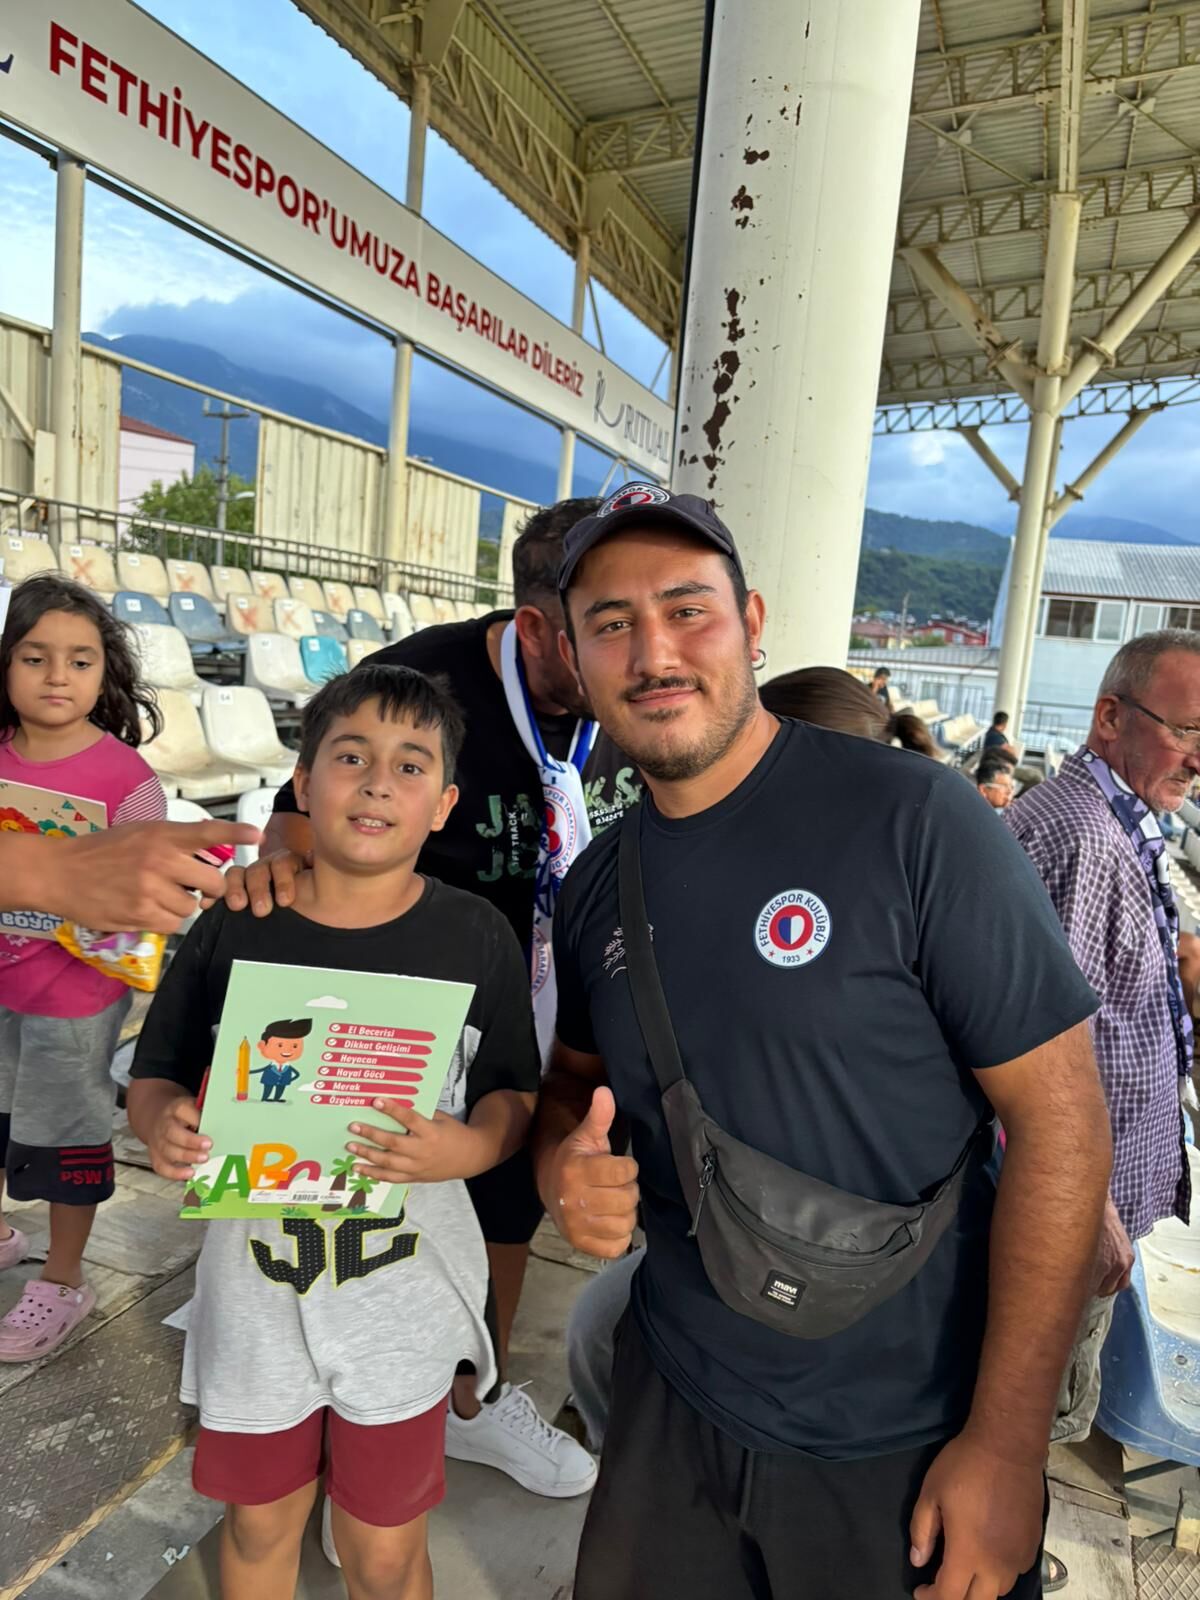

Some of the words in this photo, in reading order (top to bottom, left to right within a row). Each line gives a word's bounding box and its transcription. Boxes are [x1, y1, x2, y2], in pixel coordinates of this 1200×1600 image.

[50, 20, 421, 298] FETHİYESPOR'UMUZA
[426, 272, 529, 363] BAŞARILAR
[531, 341, 584, 398] DİLERİZ
[804, 896, 827, 942] KULÜBÜ
[782, 955, 800, 963] 1933
[359, 1026, 396, 1038] Becerisi
[344, 1039, 373, 1050] Dikkat
[375, 1042, 411, 1054] Gelişimi
[336, 1068, 362, 1079] Hayal
[363, 1069, 386, 1079] Gücü
[332, 1082, 361, 1091] Merak
[773, 1280, 798, 1295] mavi
